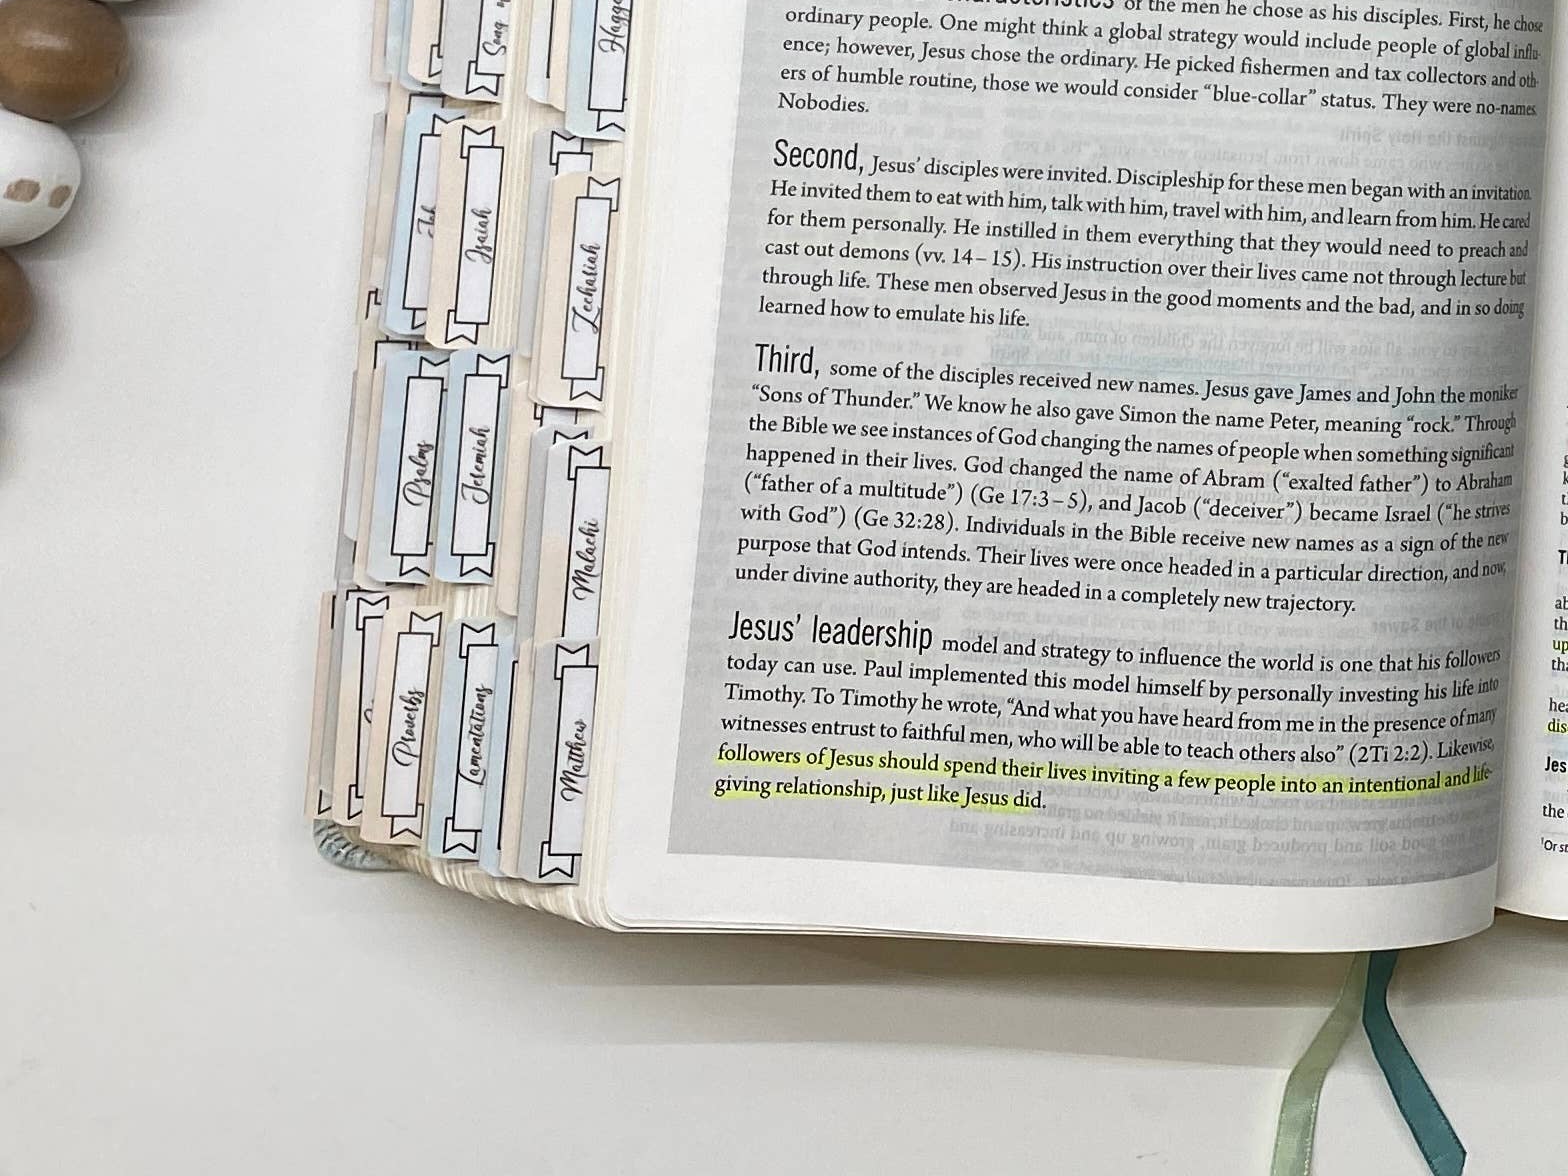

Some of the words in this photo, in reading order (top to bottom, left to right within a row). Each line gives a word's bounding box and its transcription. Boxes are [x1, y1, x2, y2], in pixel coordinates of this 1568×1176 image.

[482, 20, 508, 57] Song
[773, 138, 864, 177] Second,
[463, 207, 494, 265] Isaiah
[570, 240, 604, 334] Zechariah
[754, 343, 820, 380] Third,
[403, 441, 434, 507] Psalms
[460, 425, 492, 507] Jeremiah
[570, 518, 603, 601] Malachi
[727, 610, 802, 643] Jesus’
[812, 614, 933, 656] leadership
[391, 687, 425, 767] Proverbs
[457, 682, 492, 787] Lamentations
[558, 718, 589, 802] Matthew
[717, 741, 801, 764] followers
[806, 746, 827, 765] of
[827, 747, 875, 771] Jesus
[878, 750, 939, 772] should
[943, 756, 997, 779] spend
[1002, 758, 1045, 779] their
[1047, 760, 1087, 782] lives
[1091, 765, 1160, 793] inviting
[1163, 775, 1173, 787] a
[1177, 769, 1212, 789] few
[1213, 773, 1276, 798] people
[1280, 775, 1317, 793] into
[1321, 781, 1344, 794] an
[1347, 772, 1442, 794] intentional
[1444, 768, 1470, 789] and
[1473, 761, 1492, 783] life-
[713, 774, 772, 800] giving
[775, 775, 886, 804] relationship,
[889, 782, 924, 805] just
[926, 783, 960, 803] like
[963, 786, 1009, 809] Jesus
[1013, 789, 1047, 809] did.
